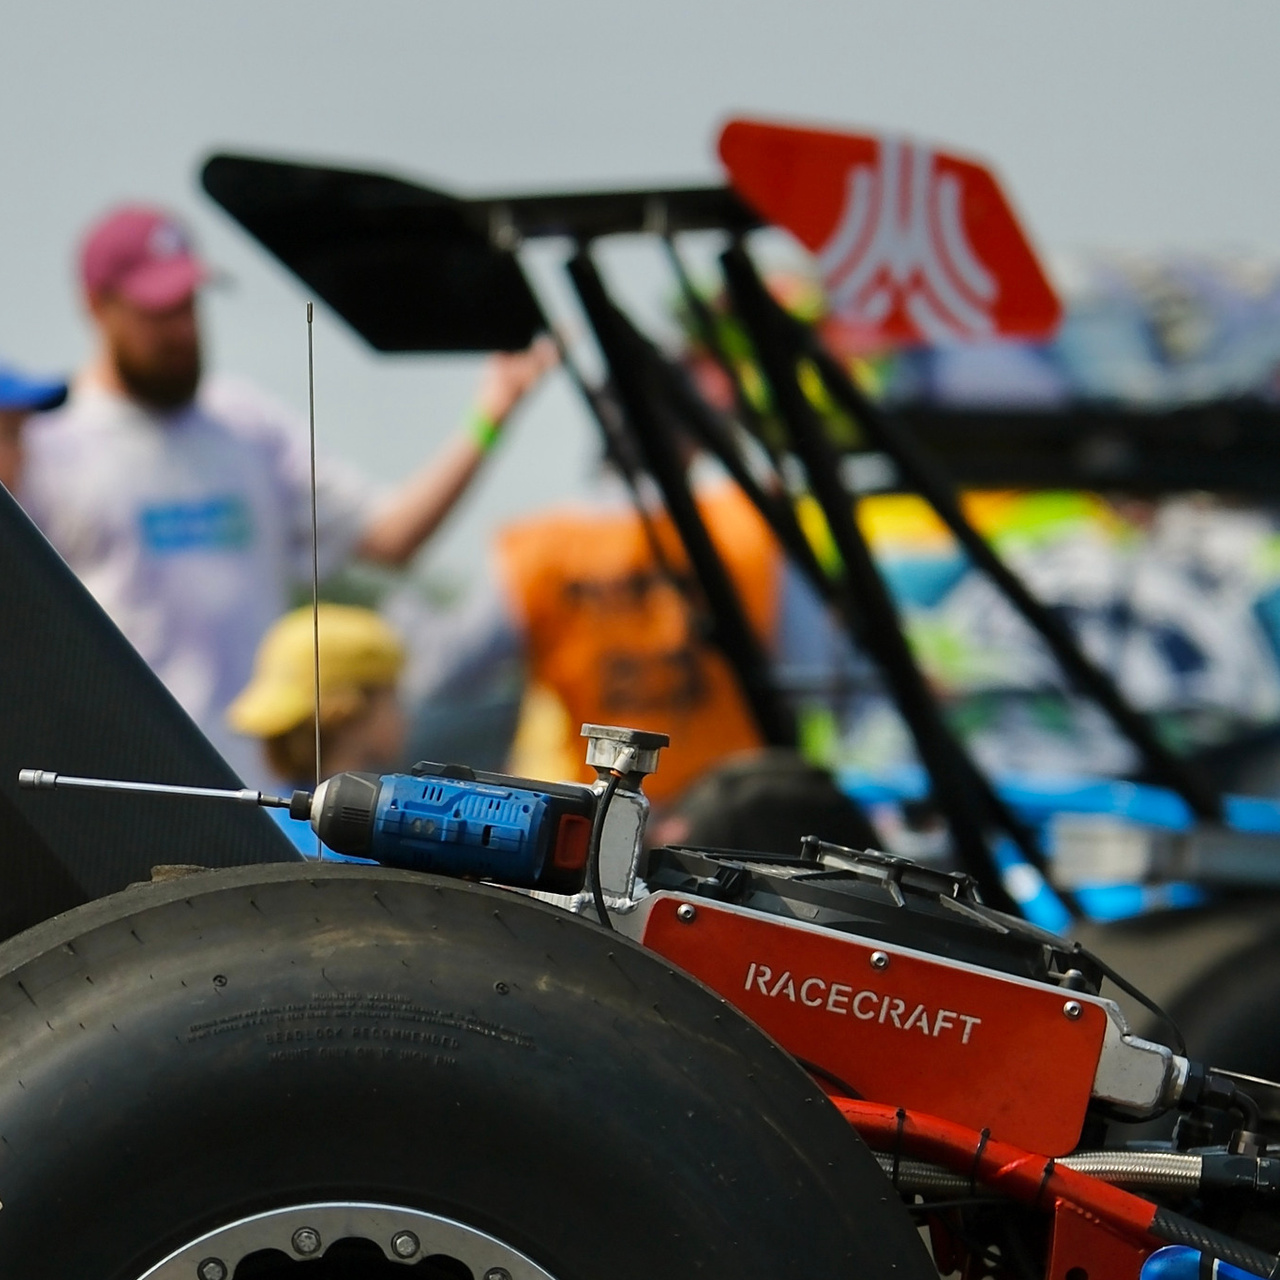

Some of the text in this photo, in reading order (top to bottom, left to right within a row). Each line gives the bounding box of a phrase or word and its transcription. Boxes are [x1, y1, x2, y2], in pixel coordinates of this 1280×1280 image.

[744, 962, 982, 1045] RACECRAFT
[263, 1026, 343, 1047] BEADLOCK
[351, 1025, 462, 1051] RECOMMENDED
